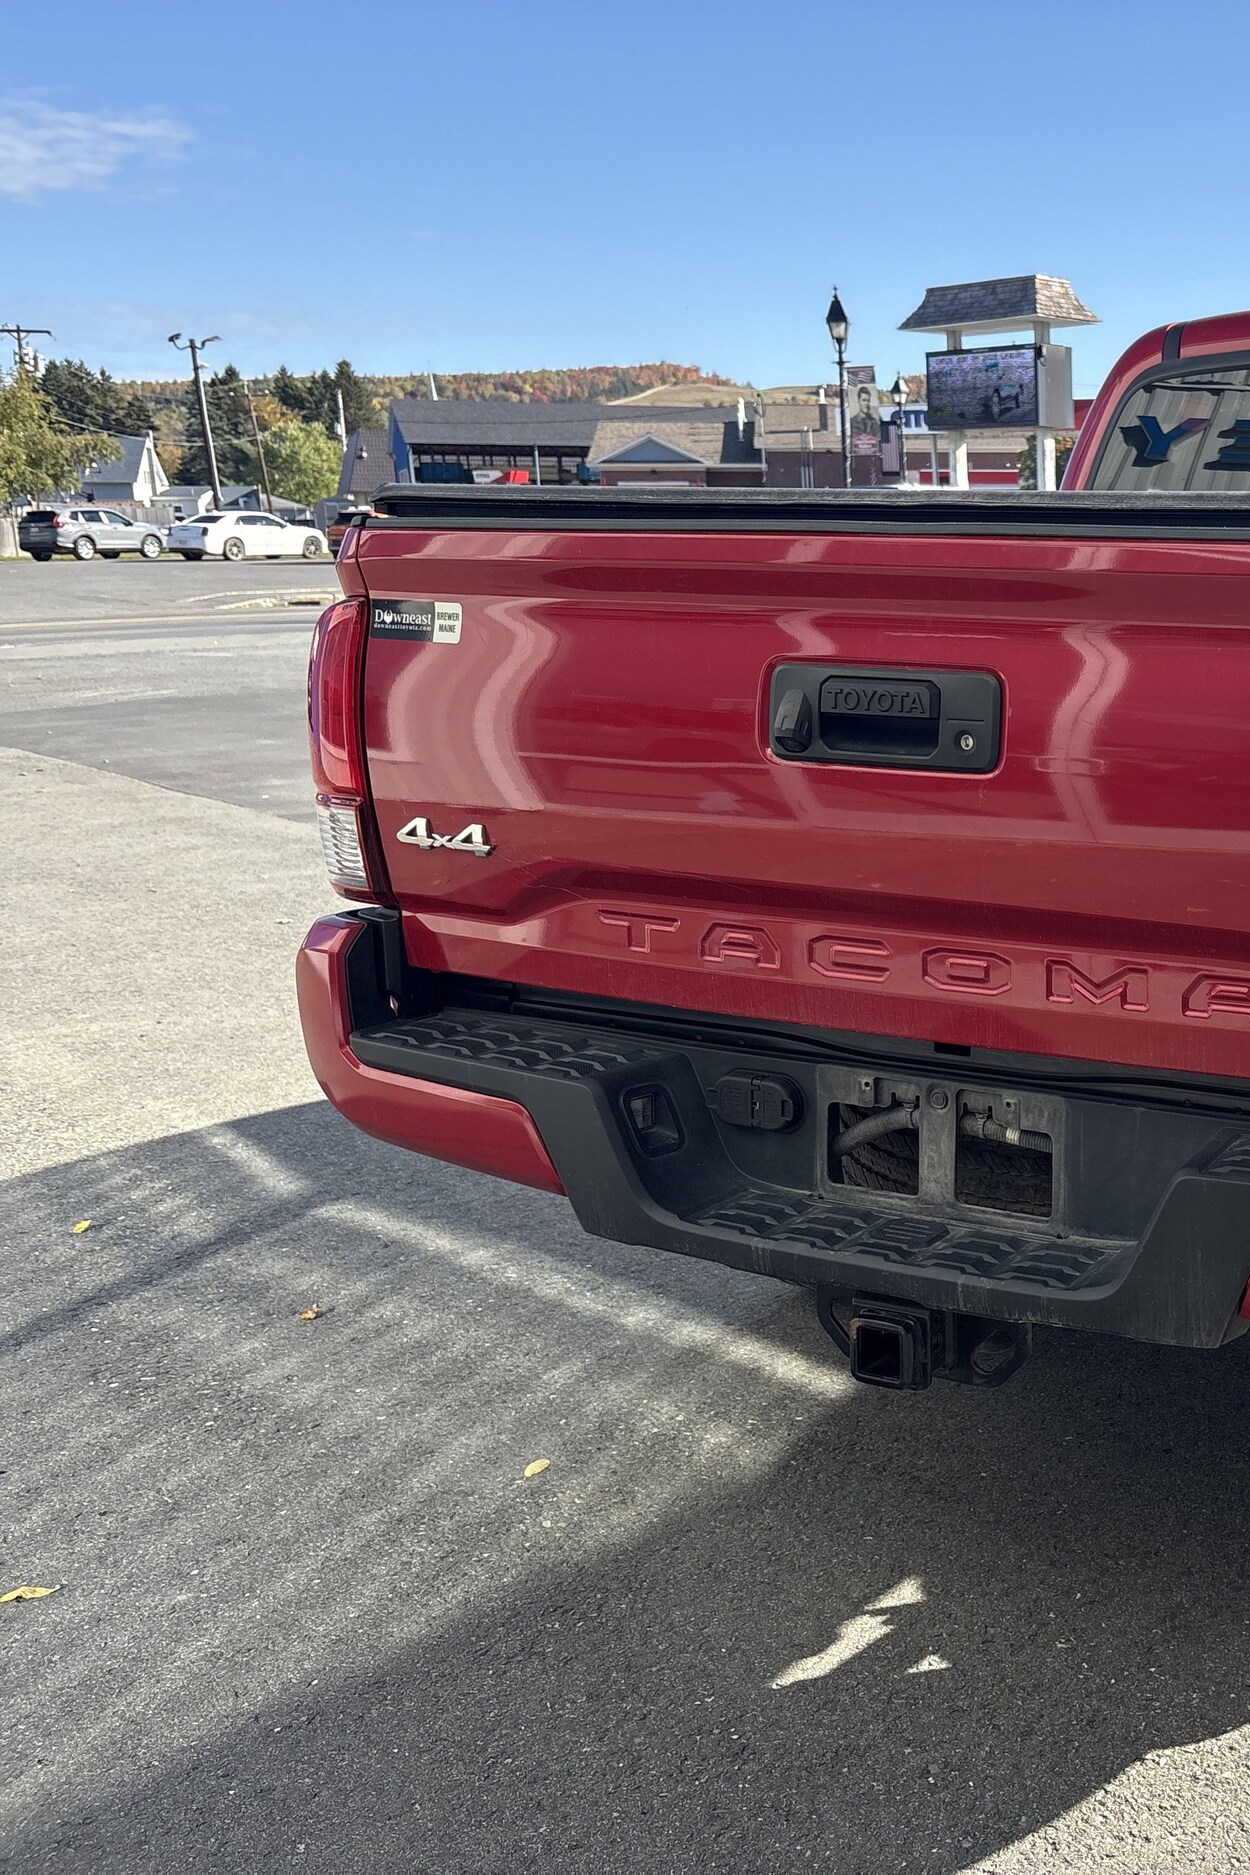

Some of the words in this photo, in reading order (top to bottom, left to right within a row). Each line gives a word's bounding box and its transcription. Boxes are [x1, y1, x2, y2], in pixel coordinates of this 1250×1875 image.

[374, 609, 432, 625] Downeast
[436, 611, 460, 622] BREWER
[438, 623, 456, 634] MAINE
[826, 688, 927, 715] TOYOTA
[396, 816, 492, 857] 4x4
